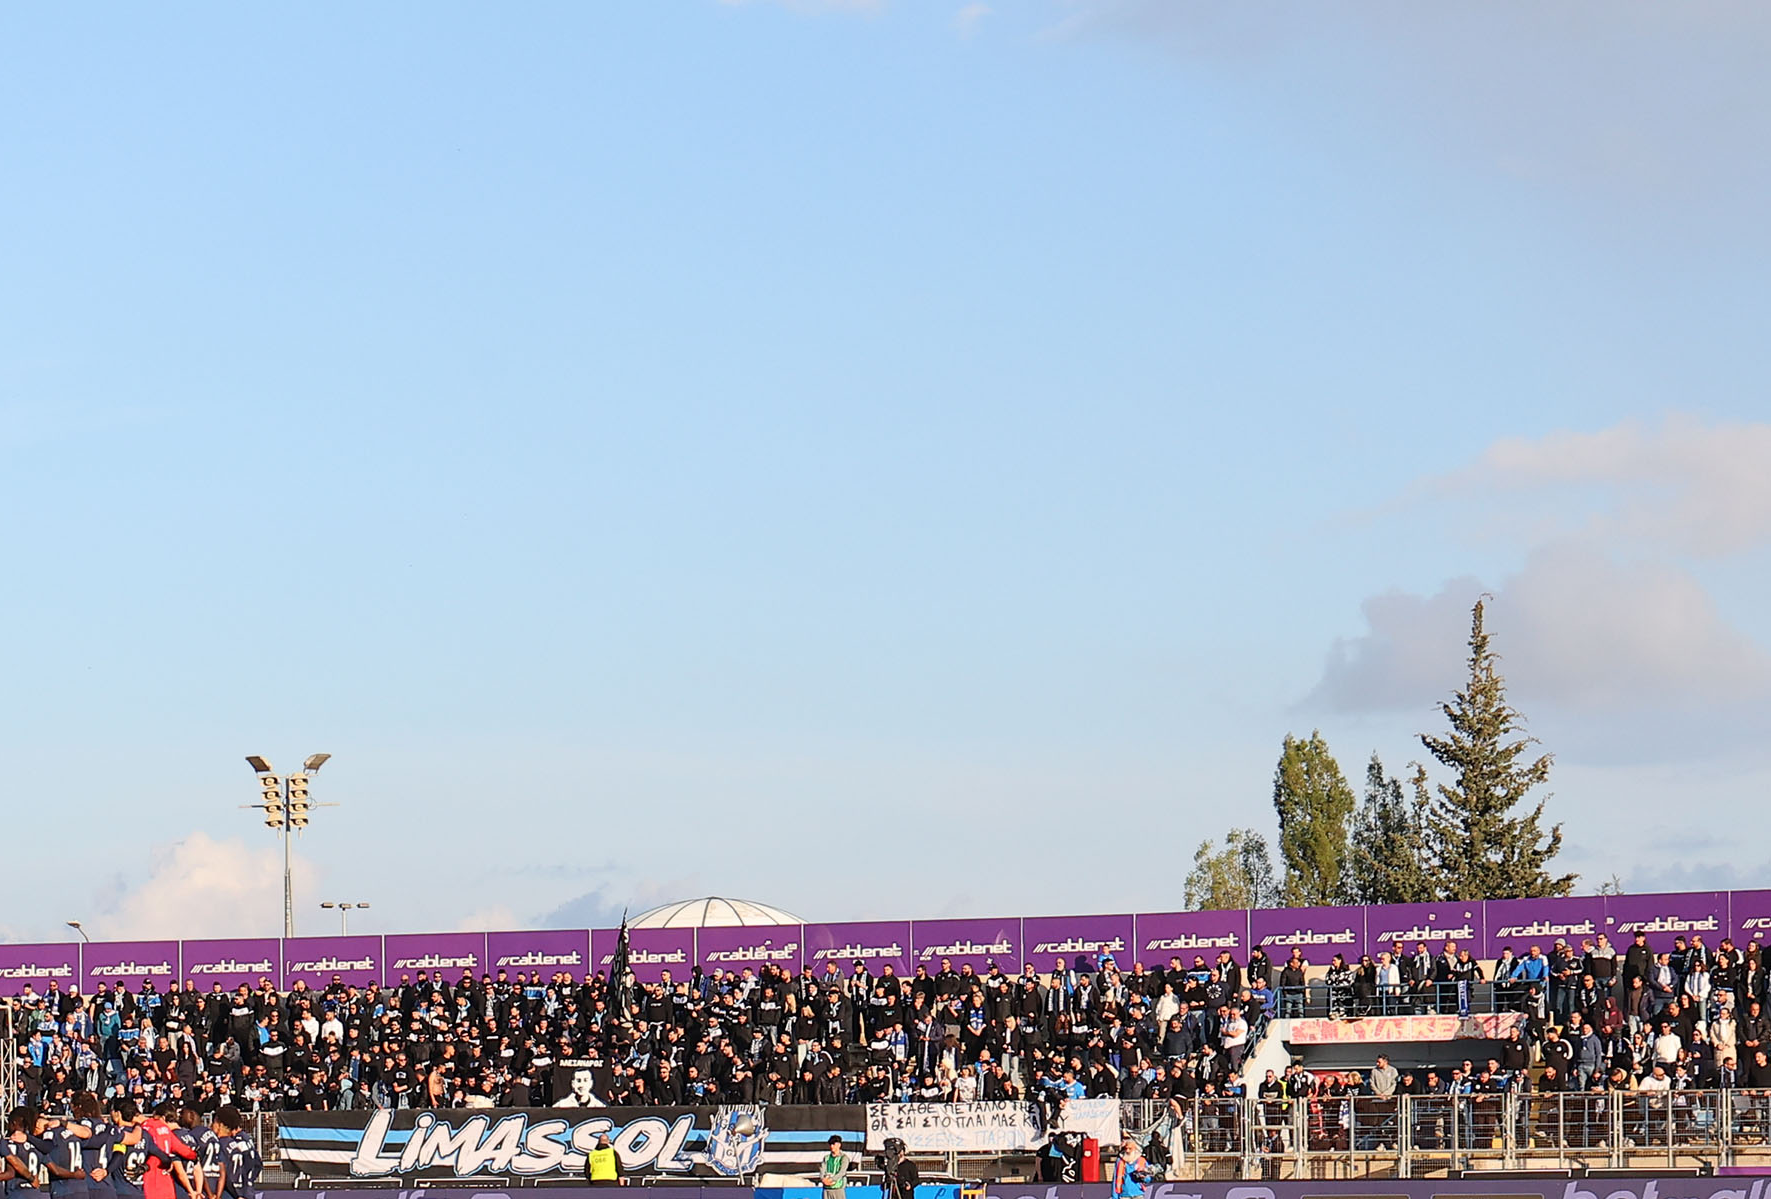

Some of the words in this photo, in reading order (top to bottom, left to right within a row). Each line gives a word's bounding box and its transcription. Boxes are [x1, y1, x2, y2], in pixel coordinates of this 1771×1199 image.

[1512, 920, 1595, 938] cablenet
[1633, 915, 1719, 933] cablenet
[1160, 932, 1239, 948] cablenet
[1273, 928, 1355, 945] cablenet
[1391, 924, 1474, 941] cablenet
[718, 945, 793, 960] cablenet
[825, 942, 901, 958] cablenet
[936, 940, 1012, 956] cablenet
[303, 957, 374, 972] cablenet
[404, 954, 478, 969] cablenet
[507, 951, 581, 966] cablenet
[3, 964, 72, 979] cablenet
[101, 961, 172, 976] cablenet
[201, 959, 272, 974] cablenet
[898, 1103, 937, 1114] ΚΑΘΕ
